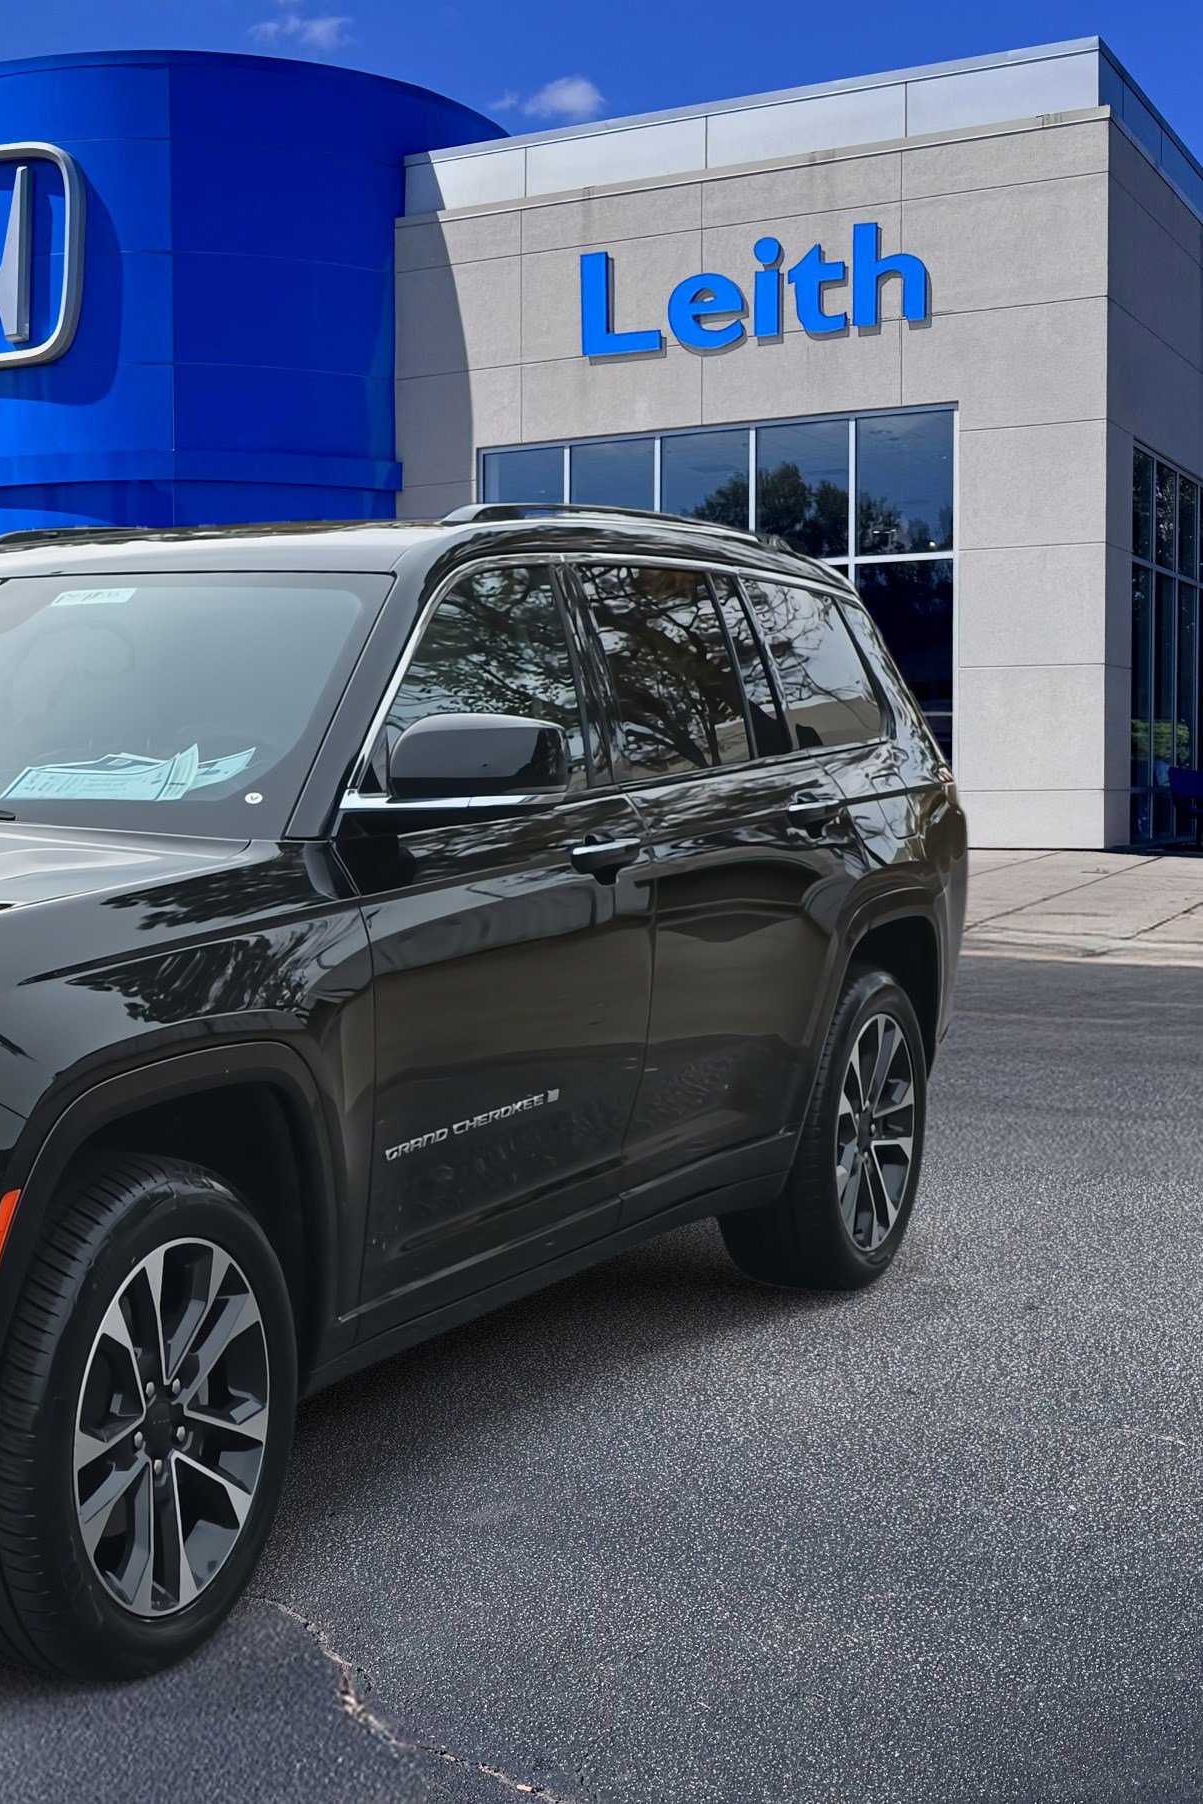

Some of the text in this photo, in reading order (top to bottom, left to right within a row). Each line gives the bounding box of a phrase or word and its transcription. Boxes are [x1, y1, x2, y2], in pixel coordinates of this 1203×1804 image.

[580, 222, 928, 357] Leith
[385, 1093, 545, 1161] GRAND CHEROKEE
